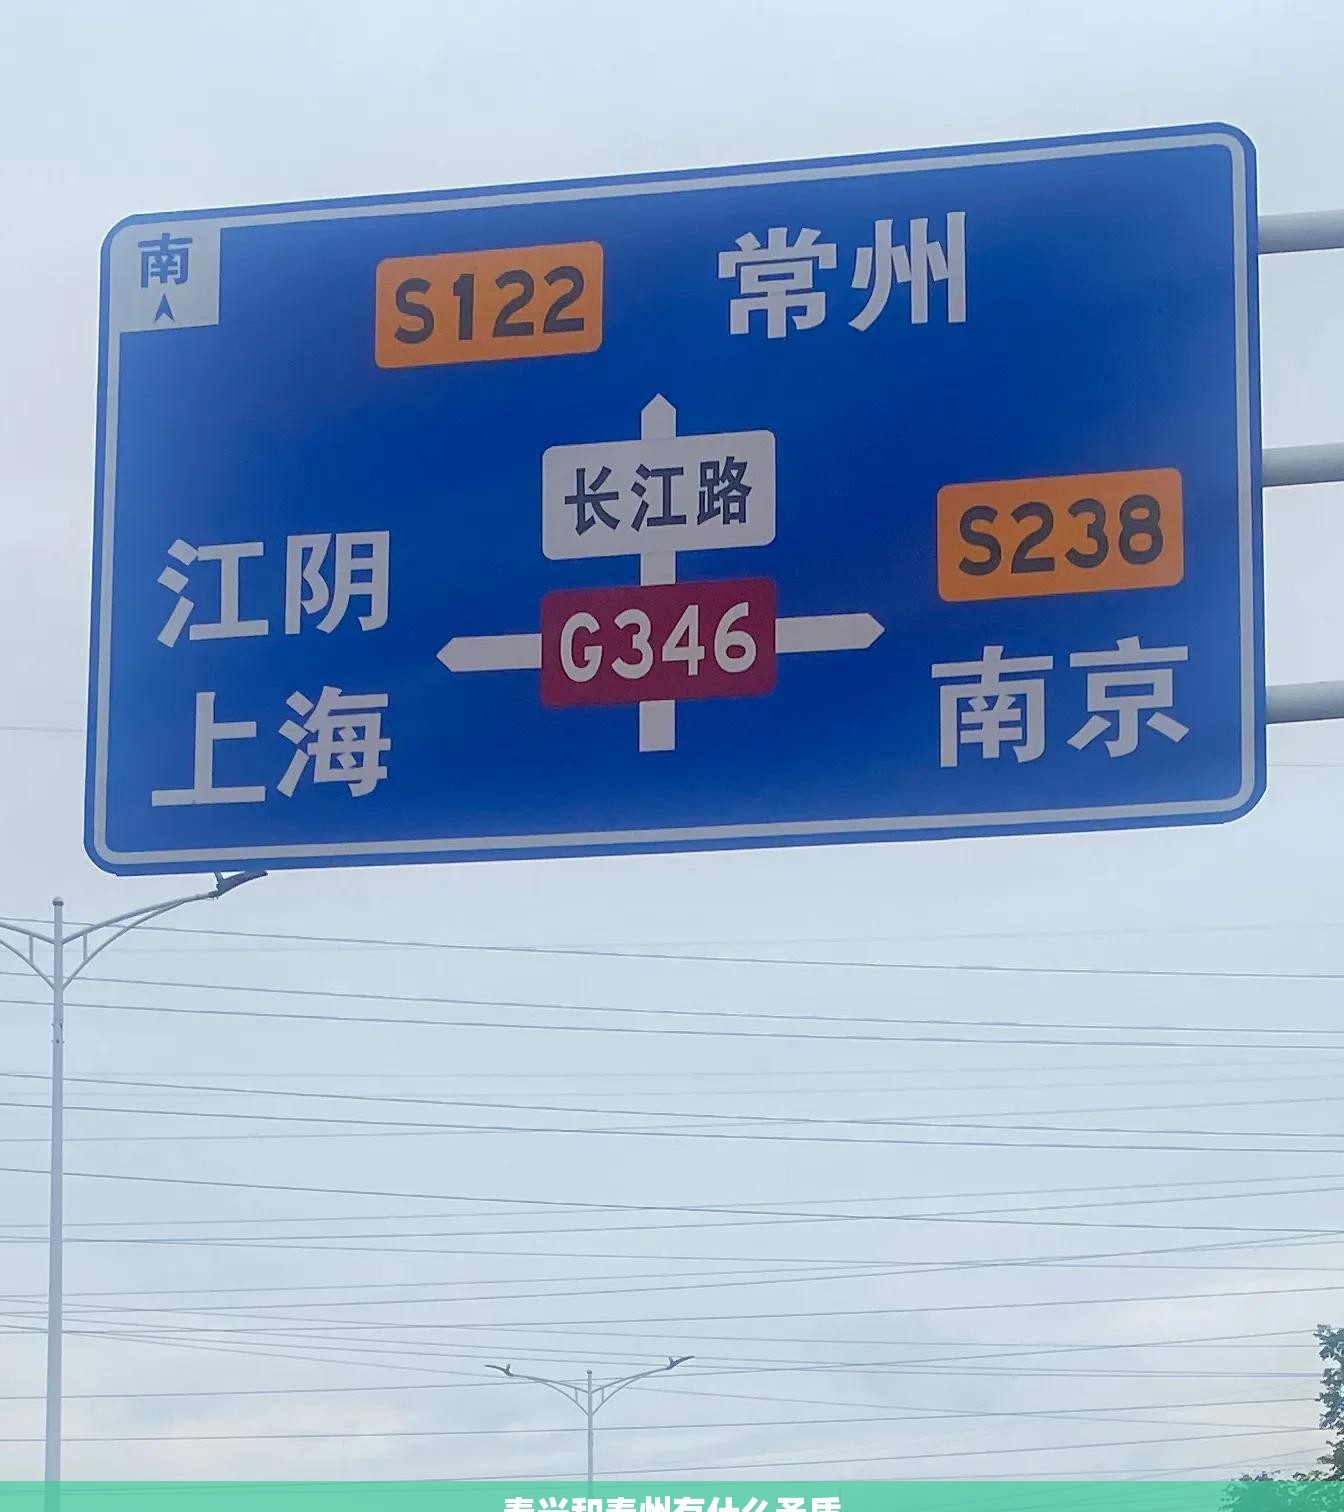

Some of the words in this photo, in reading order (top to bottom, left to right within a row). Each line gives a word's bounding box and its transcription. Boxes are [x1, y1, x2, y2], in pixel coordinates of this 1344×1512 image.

[138, 233, 192, 288] 南
[718, 211, 967, 339] 常州
[393, 265, 585, 345] S122
[564, 455, 753, 537] 长江路
[958, 494, 1164, 577] S238
[156, 530, 390, 648] 江阴
[560, 601, 757, 683] G346
[931, 635, 1190, 768] 南京
[151, 685, 392, 807] 上海
